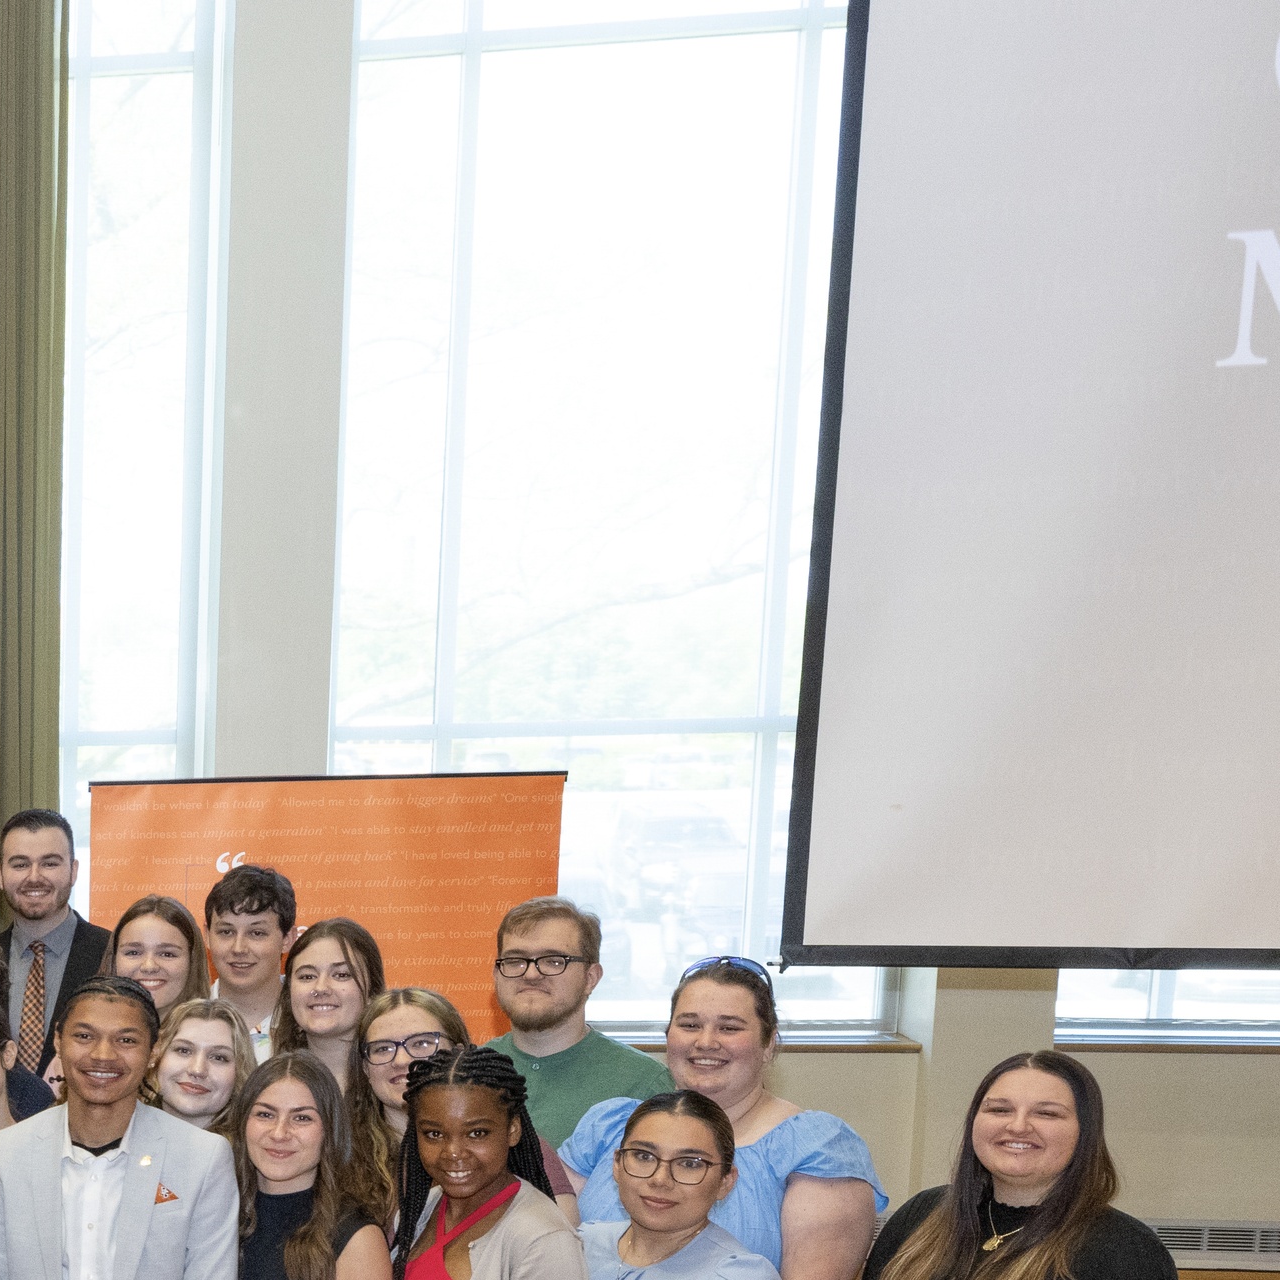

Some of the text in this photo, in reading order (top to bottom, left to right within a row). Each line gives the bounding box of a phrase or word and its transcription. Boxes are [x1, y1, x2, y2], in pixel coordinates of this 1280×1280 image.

[153, 801, 165, 811] be
[169, 801, 201, 810] where
[348, 798, 359, 806] to
[364, 794, 403, 806] dream
[407, 793, 443, 808] bigger
[116, 830, 126, 839] of
[130, 830, 177, 840] kindness
[181, 831, 200, 839] can
[202, 827, 245, 841] impact
[342, 827, 362, 836] was
[366, 824, 390, 835] able
[395, 825, 406, 835] to
[409, 823, 433, 837] stay
[436, 821, 486, 834] enrolled
[489, 820, 513, 833] and
[516, 822, 534, 835] get
[537, 822, 557, 835] my
[326, 852, 361, 865] giving
[412, 851, 437, 860] have
[442, 849, 470, 859] loved
[474, 849, 504, 861] being
[508, 848, 531, 859] able
[536, 849, 547, 858] to
[316, 878, 361, 891] passion
[365, 877, 388, 888] and
[392, 876, 416, 887] love
[418, 876, 436, 890] for
[360, 902, 440, 914] transformative
[444, 903, 463, 912] and
[467, 903, 492, 915] truly
[397, 930, 412, 940] for
[416, 931, 445, 942] years
[449, 930, 460, 938] to
[404, 954, 463, 968] extending
[466, 956, 485, 967] my
